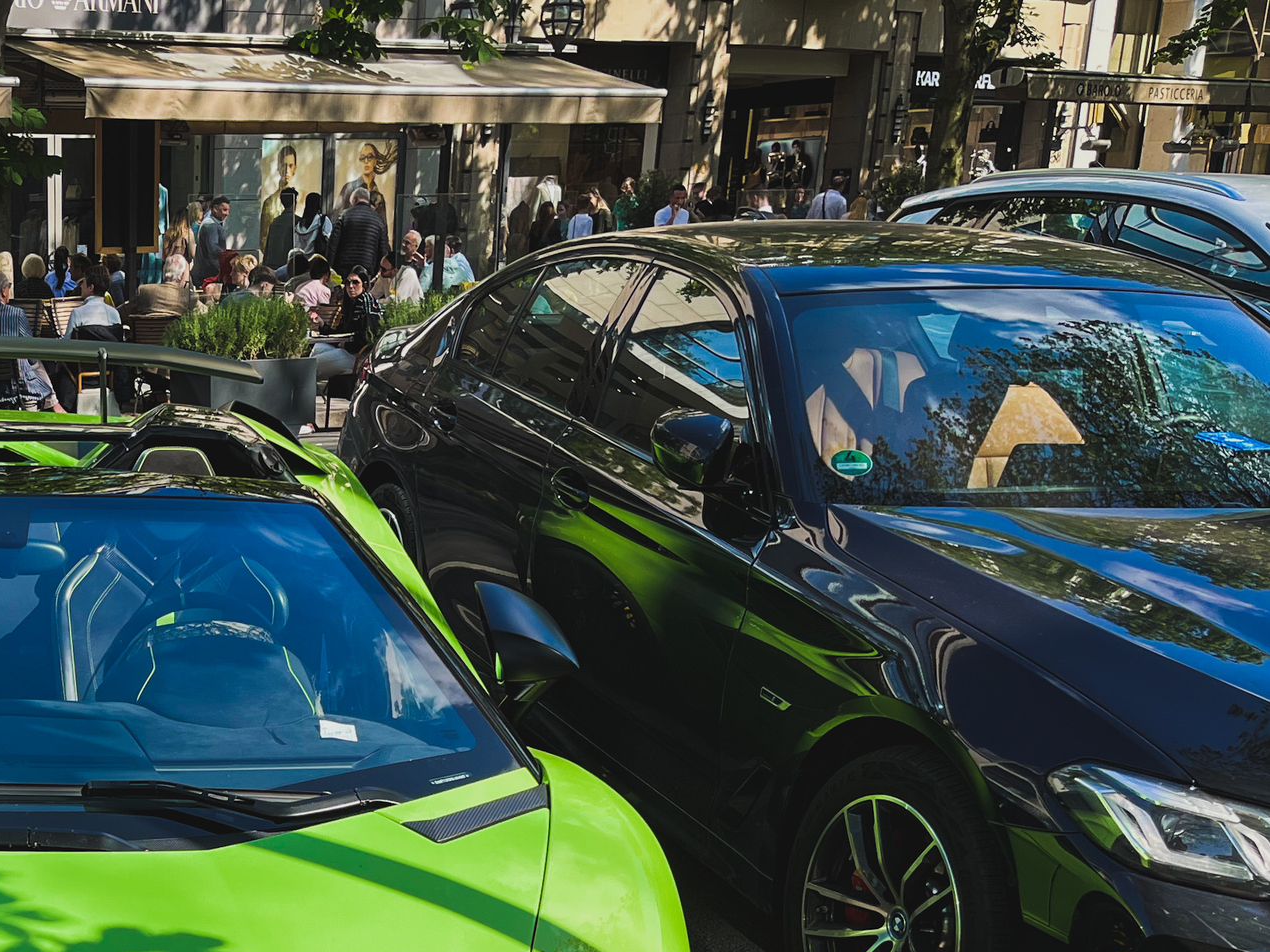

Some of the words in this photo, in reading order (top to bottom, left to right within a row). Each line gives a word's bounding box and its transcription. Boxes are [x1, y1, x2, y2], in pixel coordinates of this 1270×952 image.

[915, 70, 941, 87] KAR
[1086, 83, 1122, 98] BAROLO
[1148, 86, 1204, 101] PASTICCERIA
